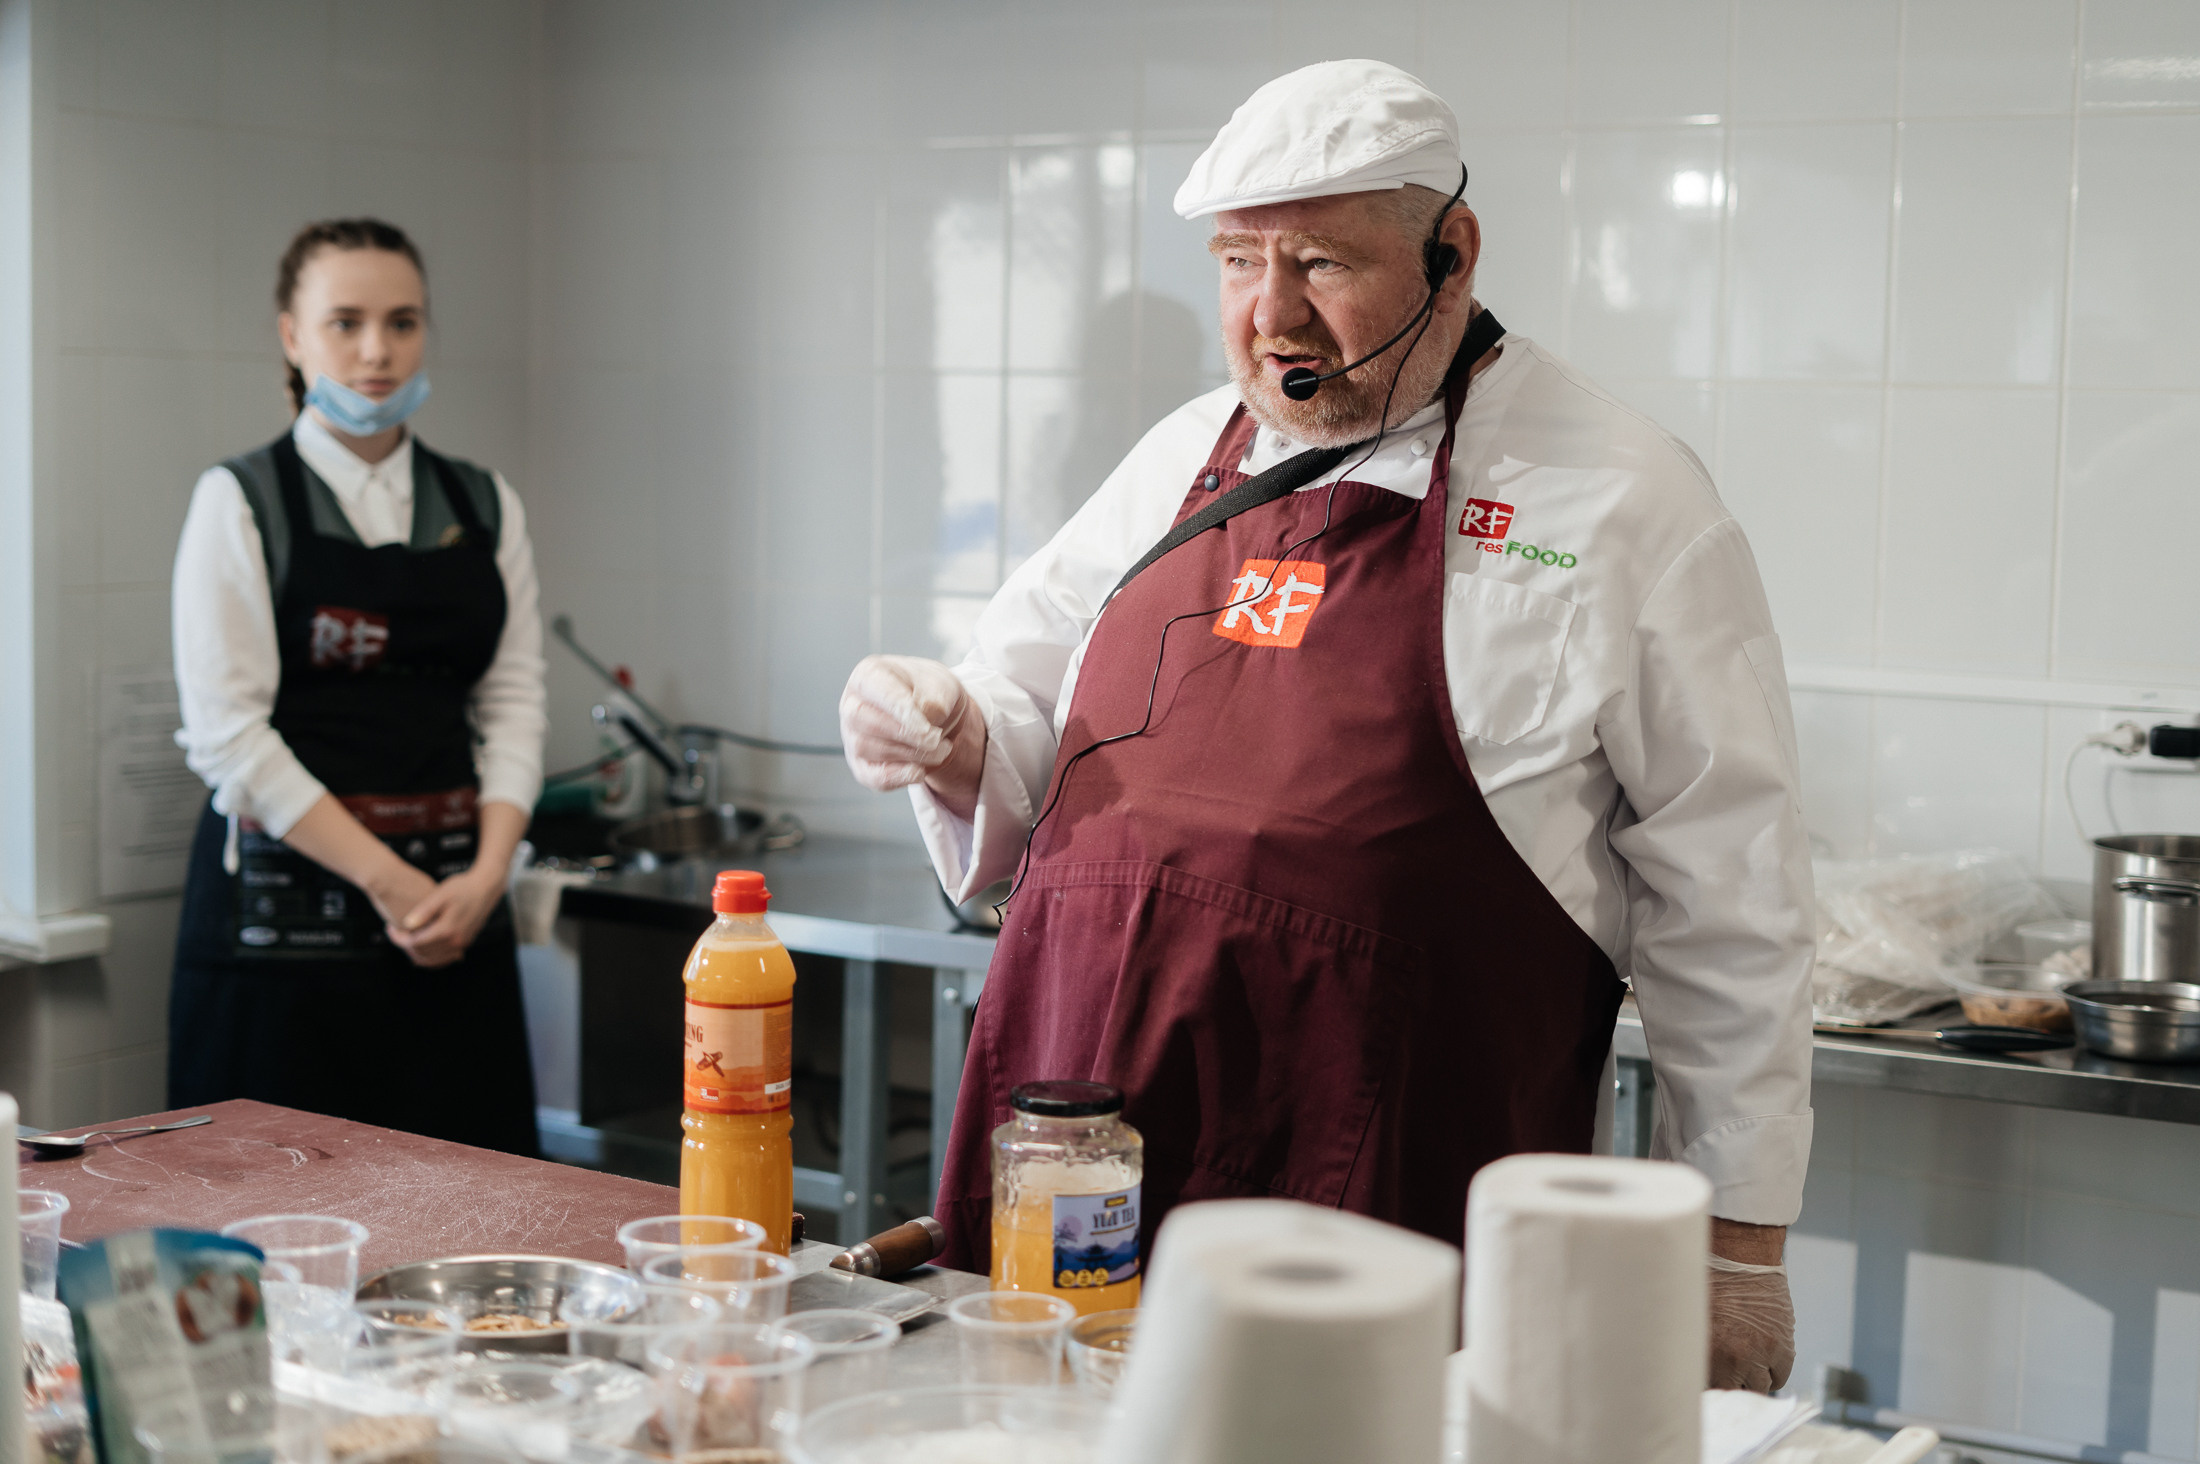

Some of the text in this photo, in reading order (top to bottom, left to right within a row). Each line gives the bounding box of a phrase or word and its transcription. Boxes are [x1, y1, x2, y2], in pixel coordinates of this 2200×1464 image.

[1462, 502, 1513, 535] RF
[1222, 568, 1325, 637] RF
[311, 611, 390, 670] RF
